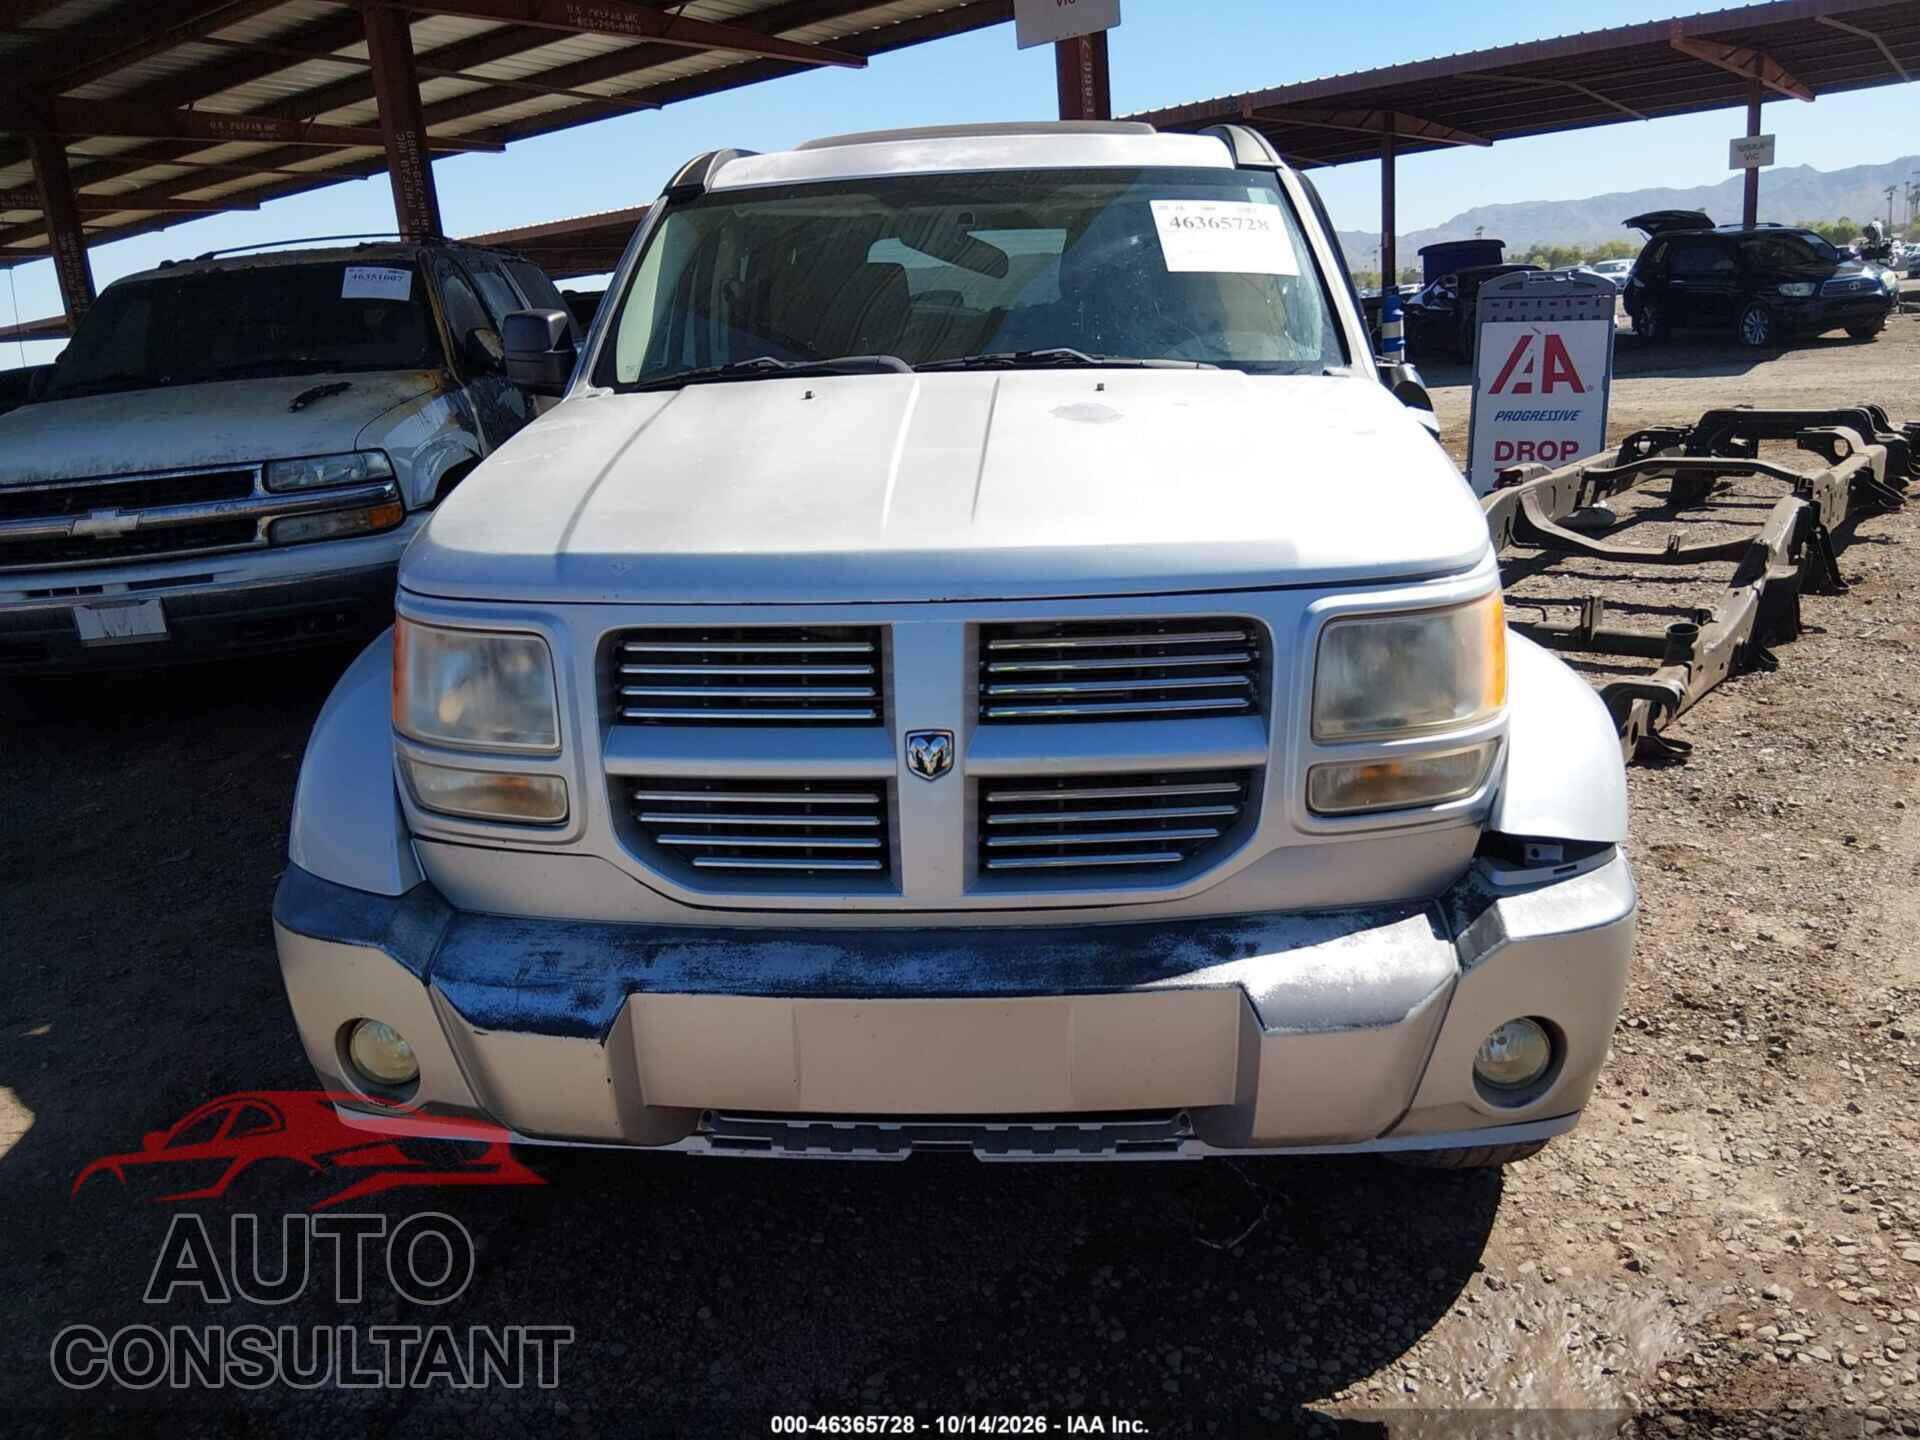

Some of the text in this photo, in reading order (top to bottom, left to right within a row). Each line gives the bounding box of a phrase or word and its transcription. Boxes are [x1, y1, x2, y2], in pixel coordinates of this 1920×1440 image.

[1169, 215, 1270, 231] 46365728
[1494, 410, 1581, 422] PROGRESSIVE
[1494, 440, 1580, 462] DROP
